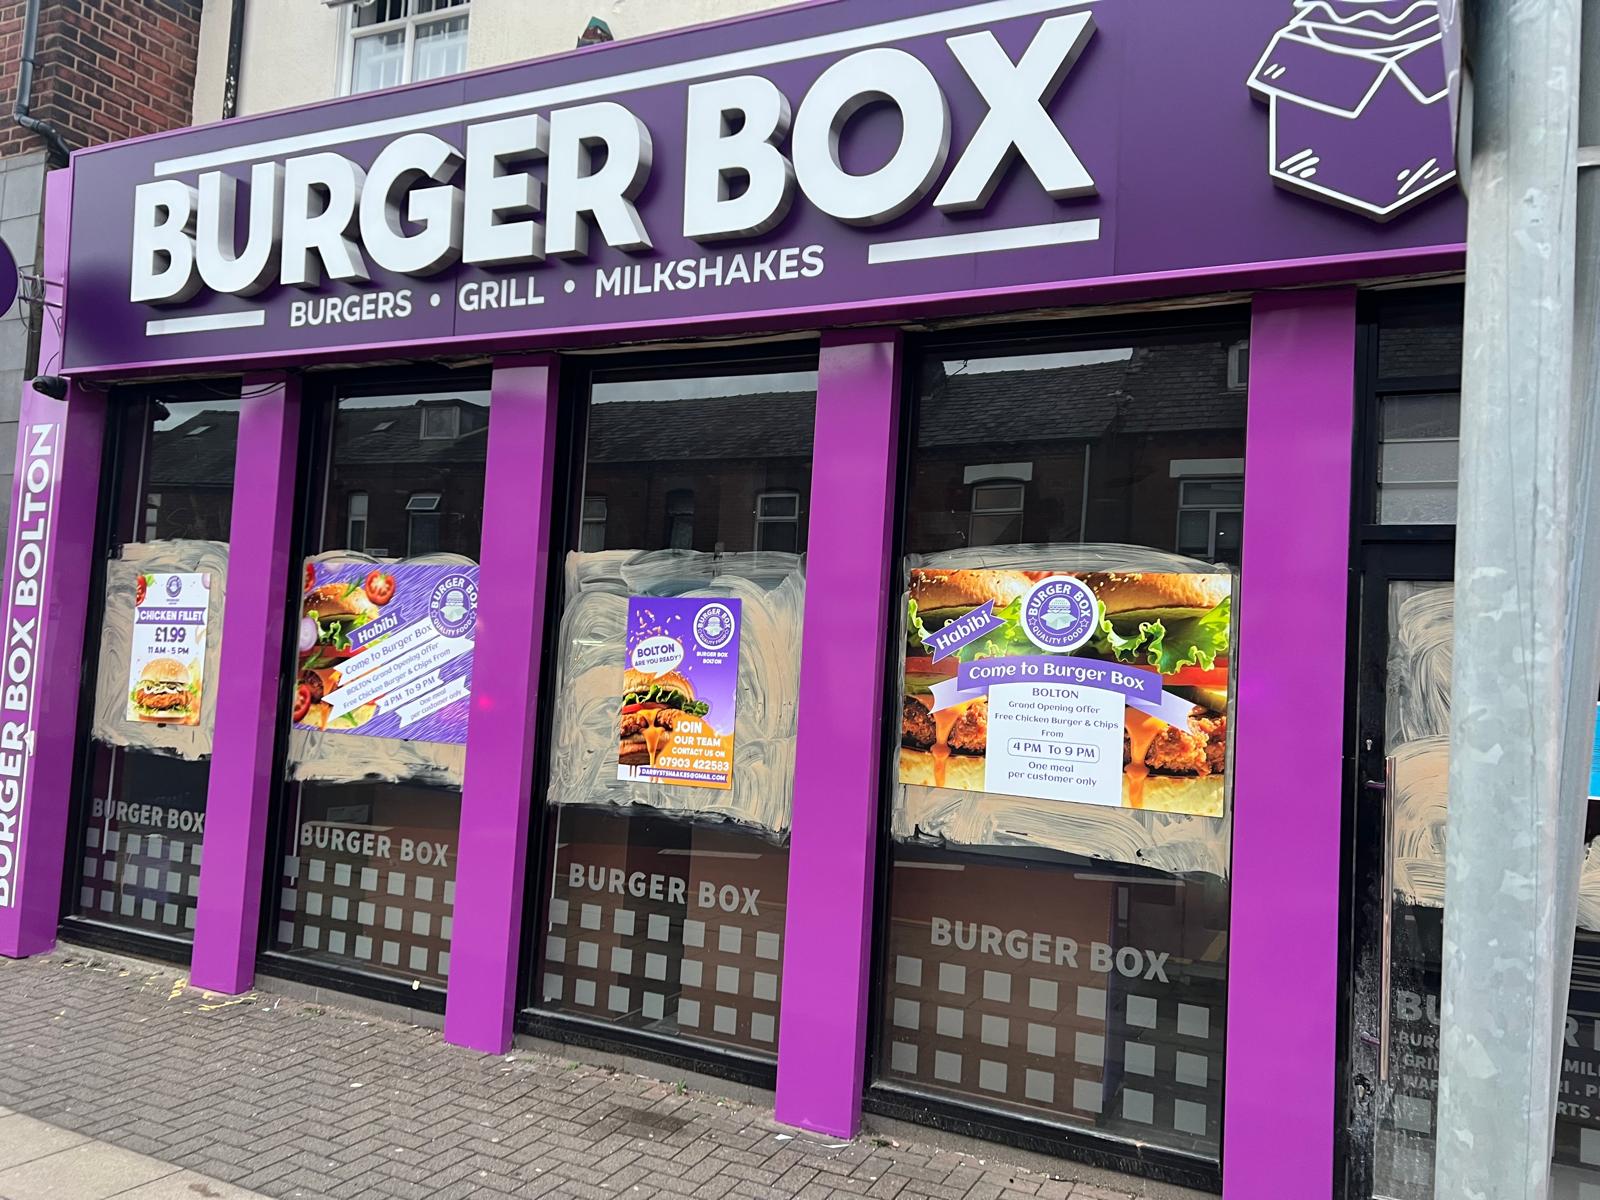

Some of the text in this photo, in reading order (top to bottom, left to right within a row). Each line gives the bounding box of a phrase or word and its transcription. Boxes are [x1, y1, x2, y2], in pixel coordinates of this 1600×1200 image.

[131, 10, 1097, 303] BURGER BOX
[290, 245, 825, 327] BURGERS GRILL MILKSHAKES
[15, 423, 53, 606] BOLTON
[431, 577, 478, 609] BURGER BOX
[1028, 583, 1091, 618] BURGER BOX
[140, 610, 203, 621] CHICKEN FILLET
[697, 608, 732, 629] BURGER BOX
[155, 626, 187, 643] £1.99
[357, 613, 398, 643] Habibi
[433, 618, 472, 636] QUALITY FOOD
[936, 610, 991, 651] Habibi
[1032, 625, 1084, 645] QUALITY FOOD
[148, 646, 154, 654] 11
[154, 646, 166, 654] AM
[171, 647, 176, 655] 5
[177, 647, 189, 655] PM
[345, 624, 433, 675] Come to Burger Box
[637, 643, 675, 658] BOLTON
[4, 617, 36, 711] BOX
[346, 642, 440, 696] BOLTON Grand Opening Offer
[634, 659, 646, 667] ARE
[659, 654, 682, 663] READY?
[343, 697, 357, 709] Free
[359, 684, 383, 701] Chicken
[384, 672, 407, 688] Burger
[413, 658, 432, 672] Chips
[433, 648, 451, 661] From
[969, 661, 1145, 691] Come to Burger Box
[384, 675, 436, 707] 4 PM To 9 PM
[1032, 687, 1079, 699] BOLTON
[421, 697, 448, 714] customer
[1008, 700, 1101, 714] Grand Opening Offer
[674, 720, 702, 734] JOIN
[994, 712, 1119, 730] Free Chicken Burger & Chips
[674, 735, 721, 747] OUR TEAM
[1041, 729, 1064, 738] From
[671, 747, 703, 756] CONTACT
[1013, 741, 1095, 758] 4 PM To 9 PM
[659, 756, 729, 771] 07903 422583
[1028, 761, 1074, 773] One meal
[1008, 770, 1097, 787] per customer only
[92, 798, 205, 834] BURGER BOX
[301, 823, 449, 867] BURGER BOX
[569, 863, 760, 916] BURGER BOX
[931, 916, 1169, 983] BURGER BOX
